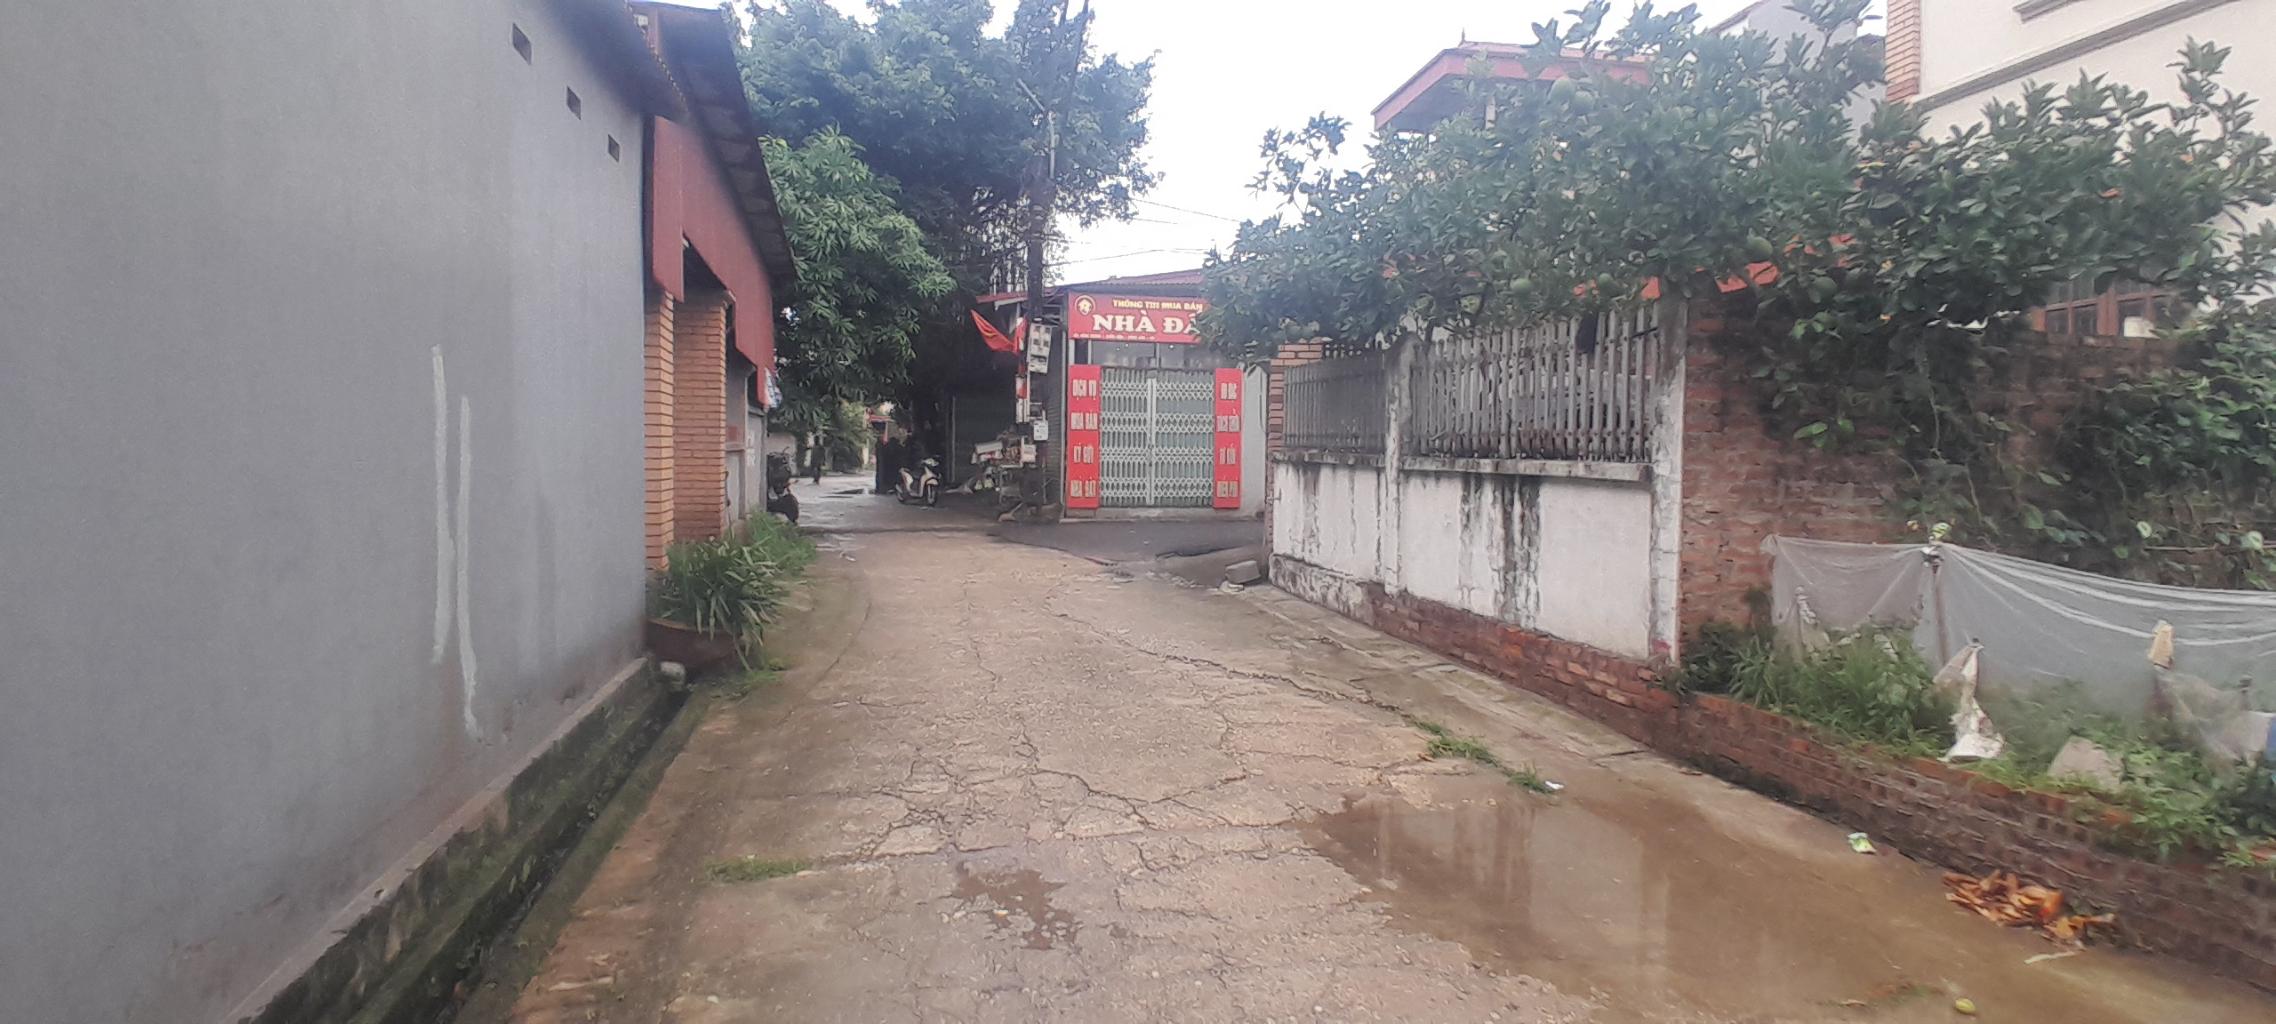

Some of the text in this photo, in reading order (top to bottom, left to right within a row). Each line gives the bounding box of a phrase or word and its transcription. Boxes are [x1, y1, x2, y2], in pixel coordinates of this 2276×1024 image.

[1161, 302, 1181, 310] MUA
[1184, 301, 1203, 311] BÁN
[1092, 310, 1201, 334] NHÀ ĐẤ
